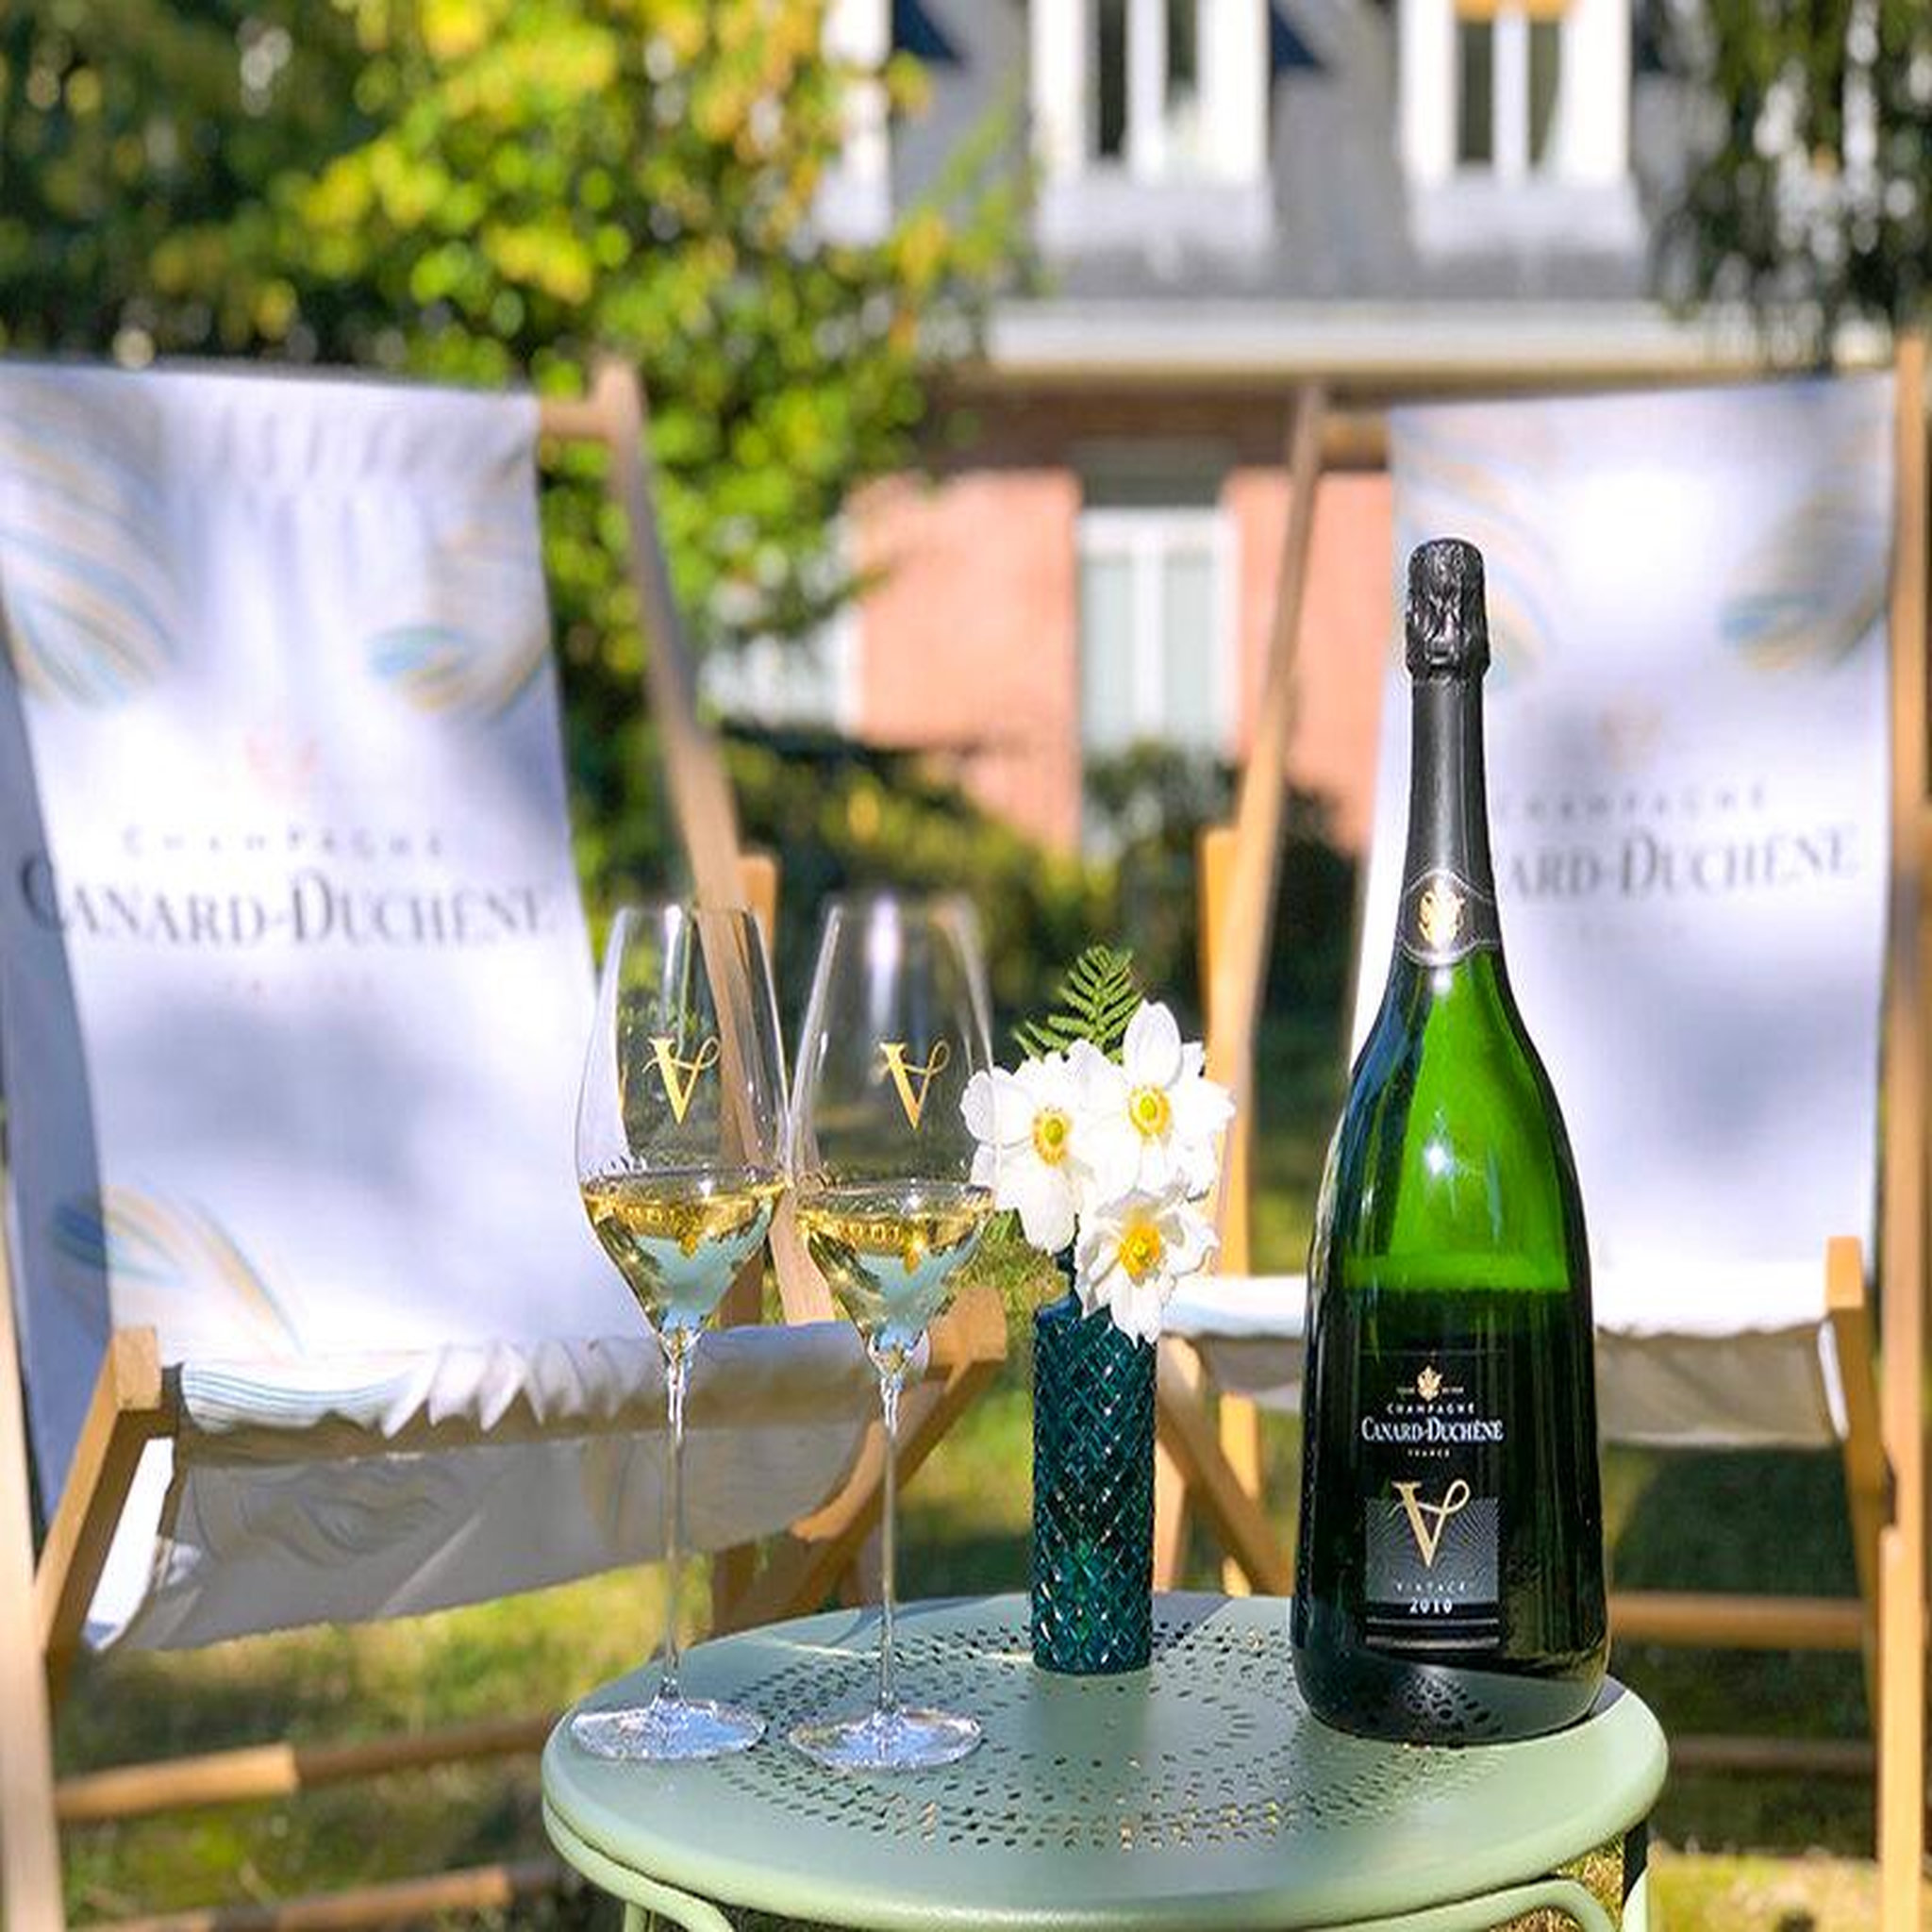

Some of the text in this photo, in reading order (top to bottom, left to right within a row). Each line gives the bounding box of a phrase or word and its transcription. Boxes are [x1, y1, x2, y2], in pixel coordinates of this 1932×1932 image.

[642, 1036, 721, 1124] V
[879, 1041, 950, 1130] V
[1386, 1403, 1474, 1415] CHAMPAGNE
[1388, 1479, 1471, 1568] V
[1409, 1597, 1453, 1613] 2010
